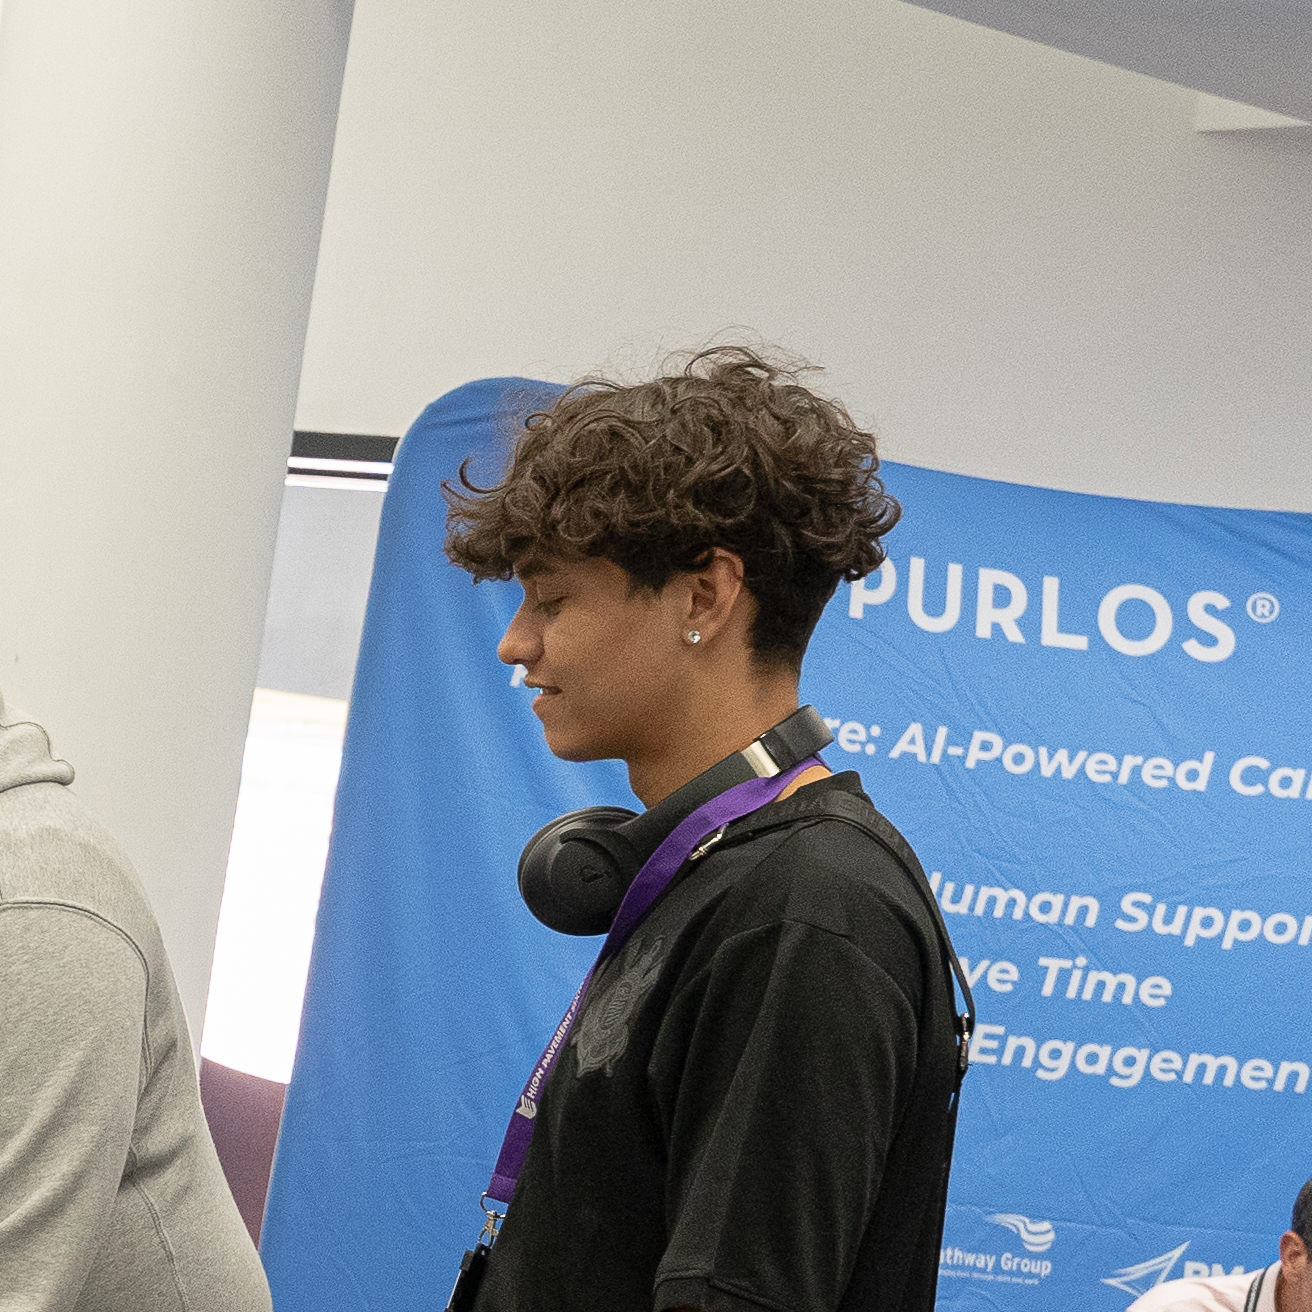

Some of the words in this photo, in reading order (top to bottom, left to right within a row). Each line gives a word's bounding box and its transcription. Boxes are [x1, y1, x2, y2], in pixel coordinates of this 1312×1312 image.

[889, 721, 1215, 793] AI-Powered
[1037, 956, 1173, 1007] Time
[527, 1068, 545, 1099] HIGH
[541, 1012, 574, 1069] PAVEMENT
[967, 1024, 1310, 1095] Engagemen
[1001, 1252, 1052, 1279] Group
